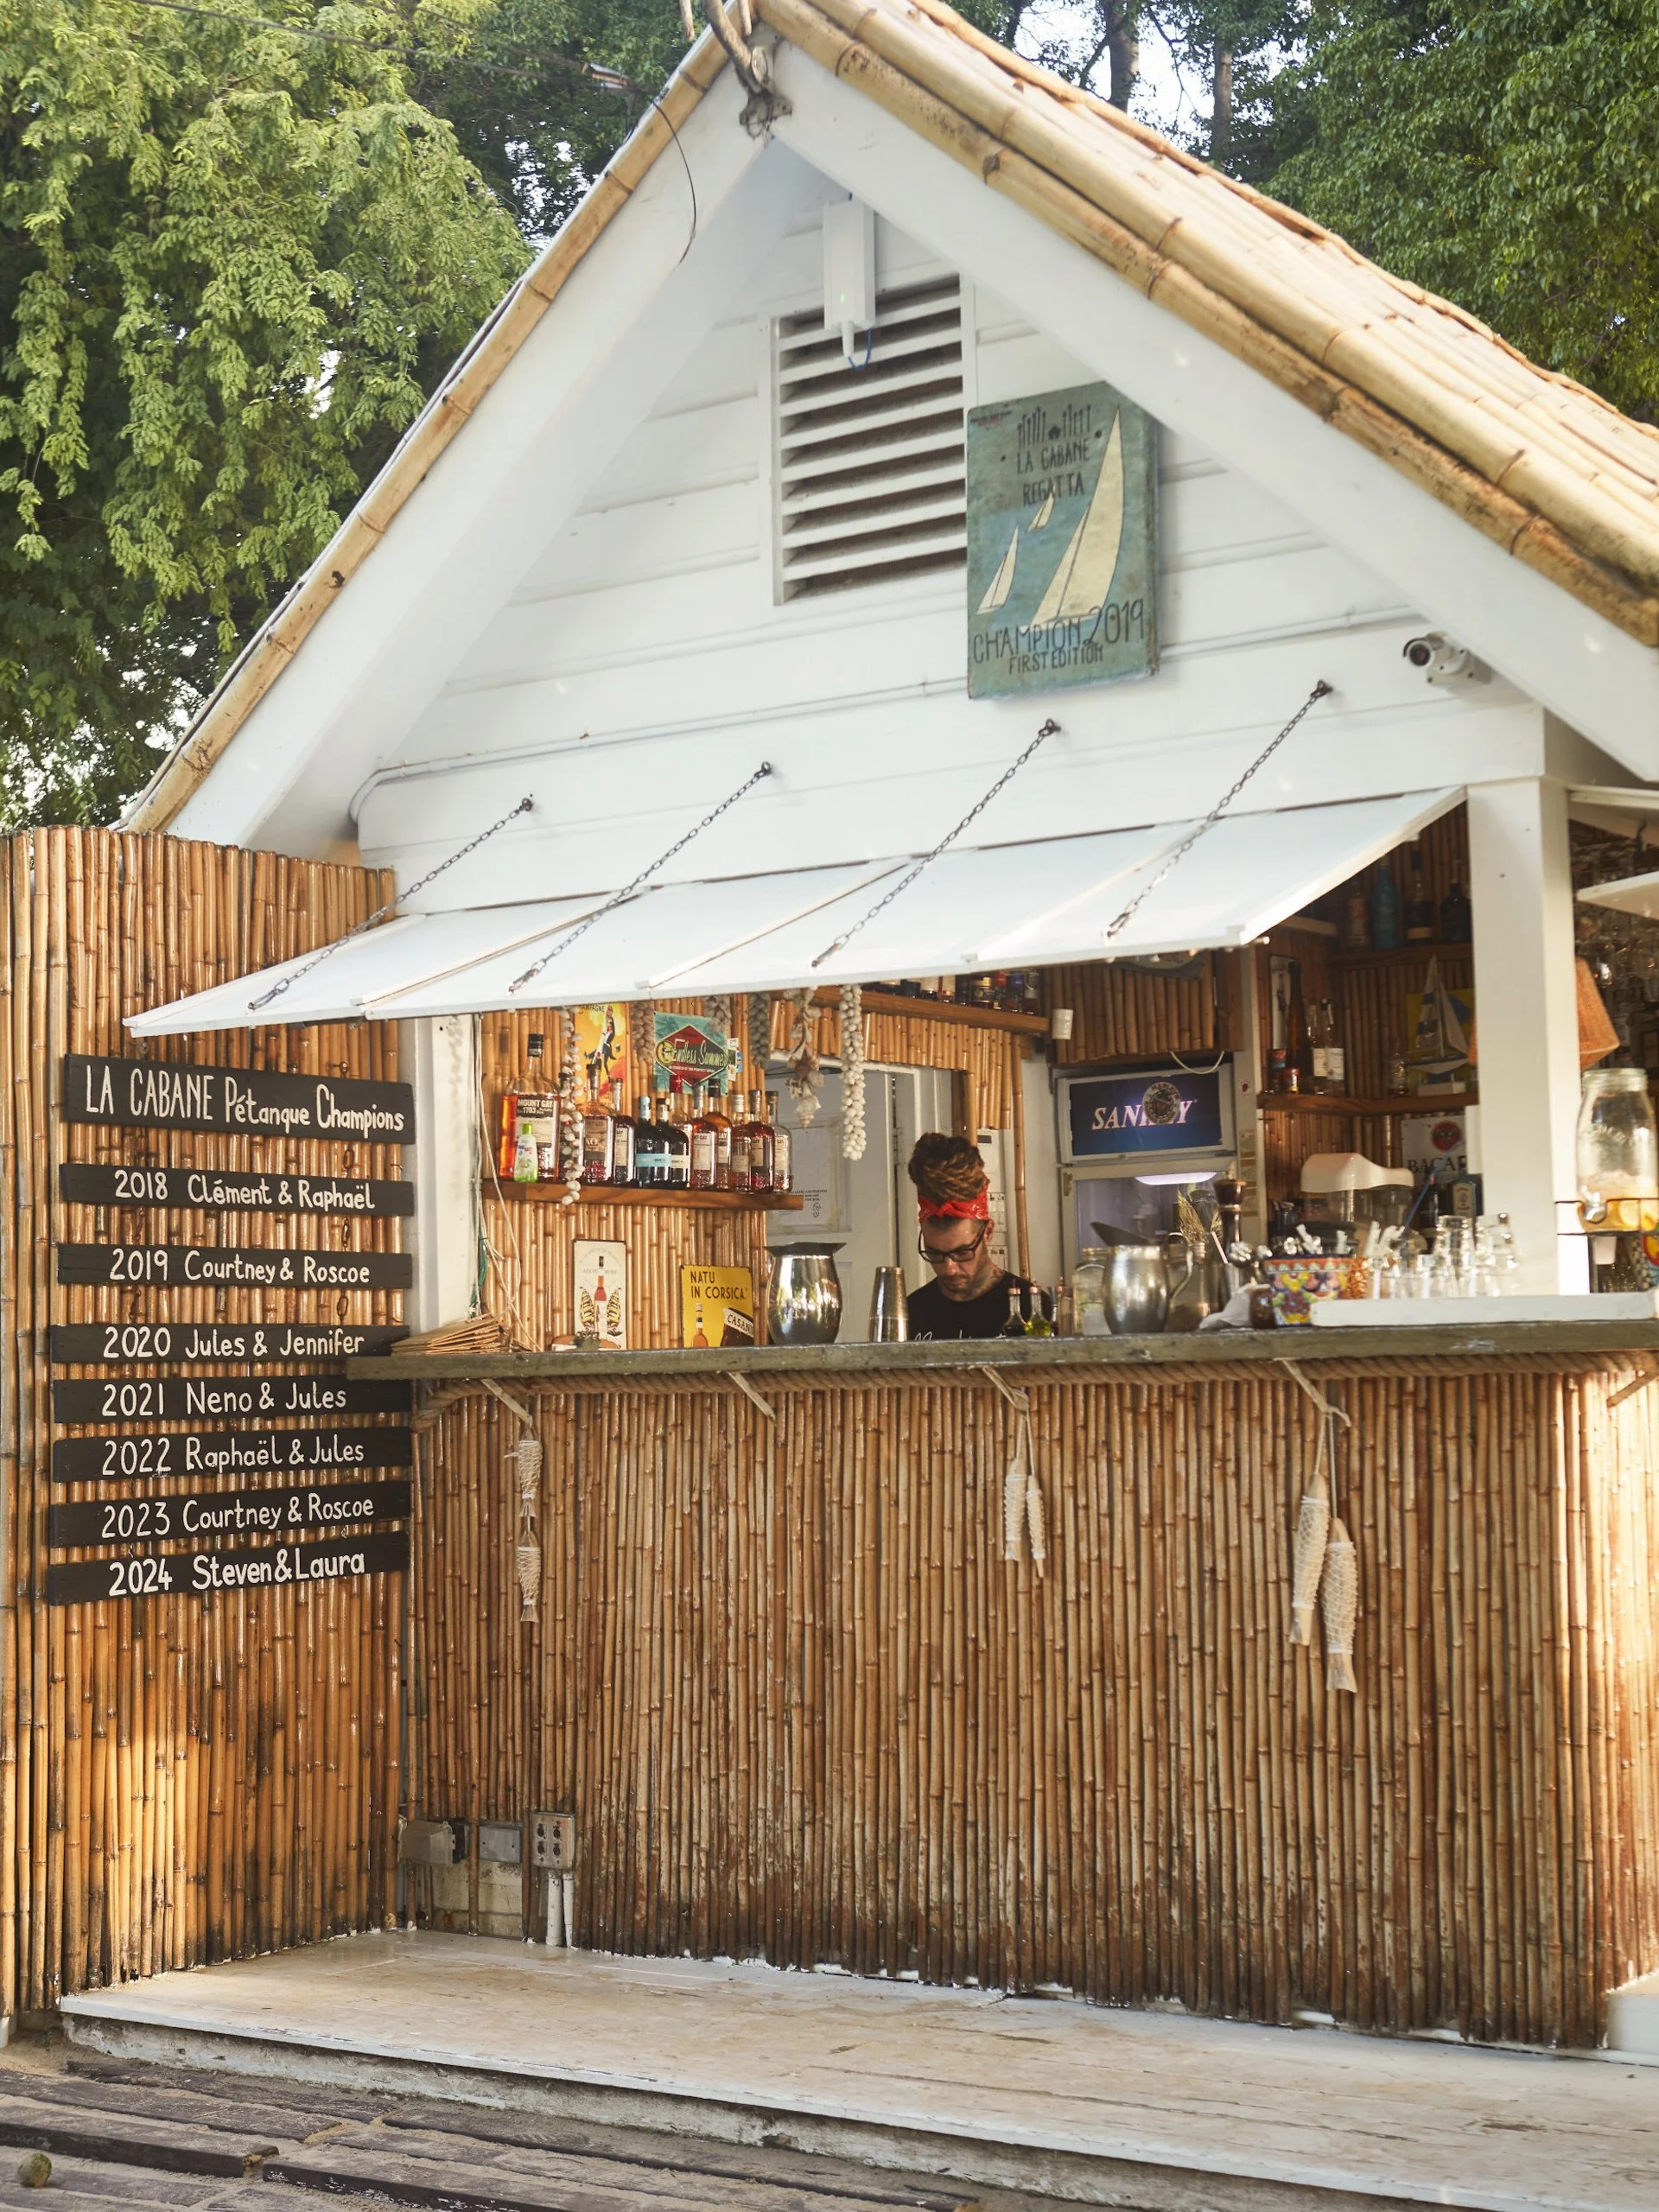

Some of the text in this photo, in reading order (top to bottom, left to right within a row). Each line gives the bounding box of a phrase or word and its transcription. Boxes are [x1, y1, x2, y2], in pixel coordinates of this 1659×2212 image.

[1017, 437, 1090, 474] LA CABANE
[1022, 471, 1085, 507] REGATTA
[973, 598, 1145, 664] CHAMPION 2019
[1008, 643, 1103, 676] FIRST EDITION
[86, 1065, 404, 1138] LA CABANE Pétanque Champions
[1091, 1100, 1194, 1130] SANY
[115, 1170, 375, 1211] 2018 Clément & Raphaël
[110, 1249, 369, 1283] 2019 Courtney & Roscoe
[690, 1271, 715, 1284] NATU
[691, 1286, 701, 1299] IN
[104, 1326, 364, 1358] 2020 Jules & Jennifer
[102, 1382, 346, 1416] 2021 Neno & Jules
[103, 1434, 364, 1475] 2022 Raphaël & Jules
[102, 1493, 373, 1538] 2023 Courtney & Roscoe
[109, 1548, 365, 1596] 2024 Steven & Laura
